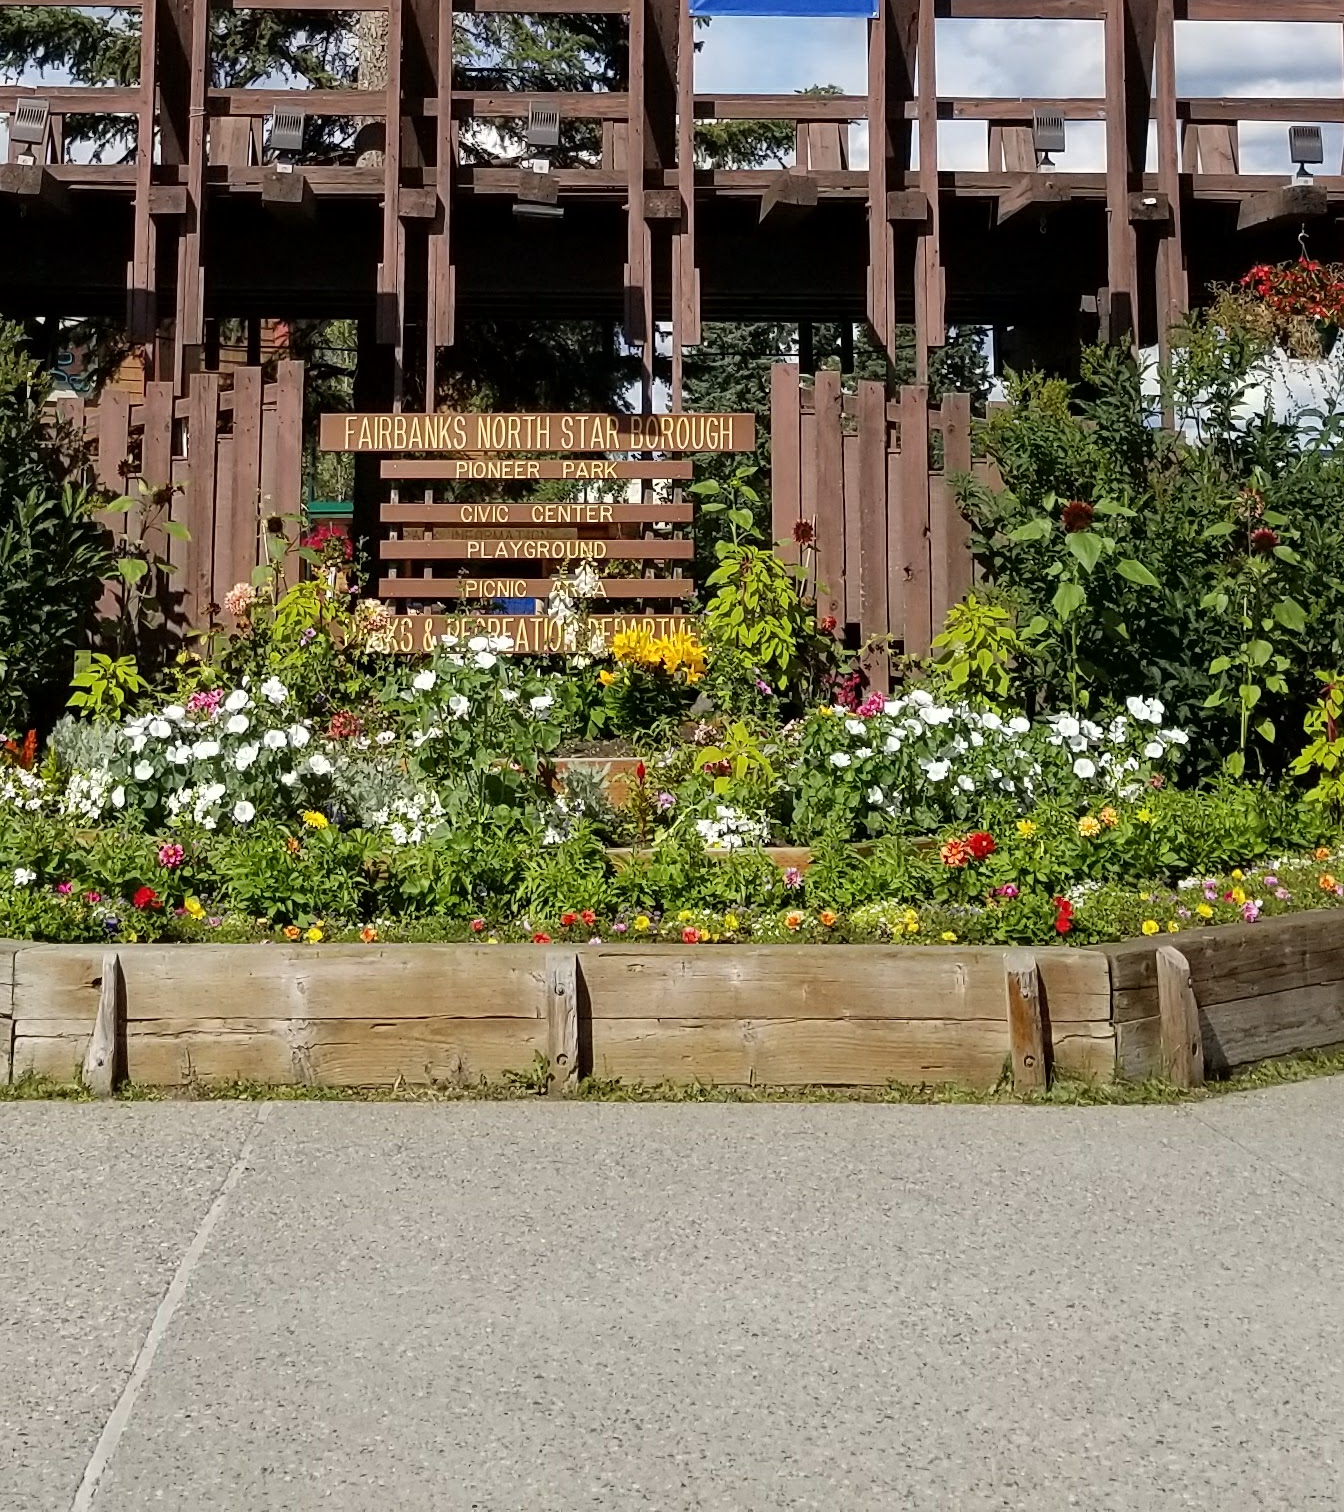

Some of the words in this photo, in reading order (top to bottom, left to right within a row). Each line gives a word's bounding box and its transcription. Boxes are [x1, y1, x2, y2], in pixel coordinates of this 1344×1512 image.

[344, 416, 467, 450] FAIRBANKS
[477, 416, 550, 450] NORTH
[561, 416, 620, 450] STAR
[631, 416, 733, 450] BOROUGH
[456, 461, 540, 479] PIONEER
[562, 461, 618, 479] PARK
[460, 505, 509, 523] CIVIC
[531, 505, 613, 523] CENTER
[467, 541, 607, 559] PLAYGROUND
[465, 580, 527, 598] PICNIC
[551, 580, 607, 598] ARA
